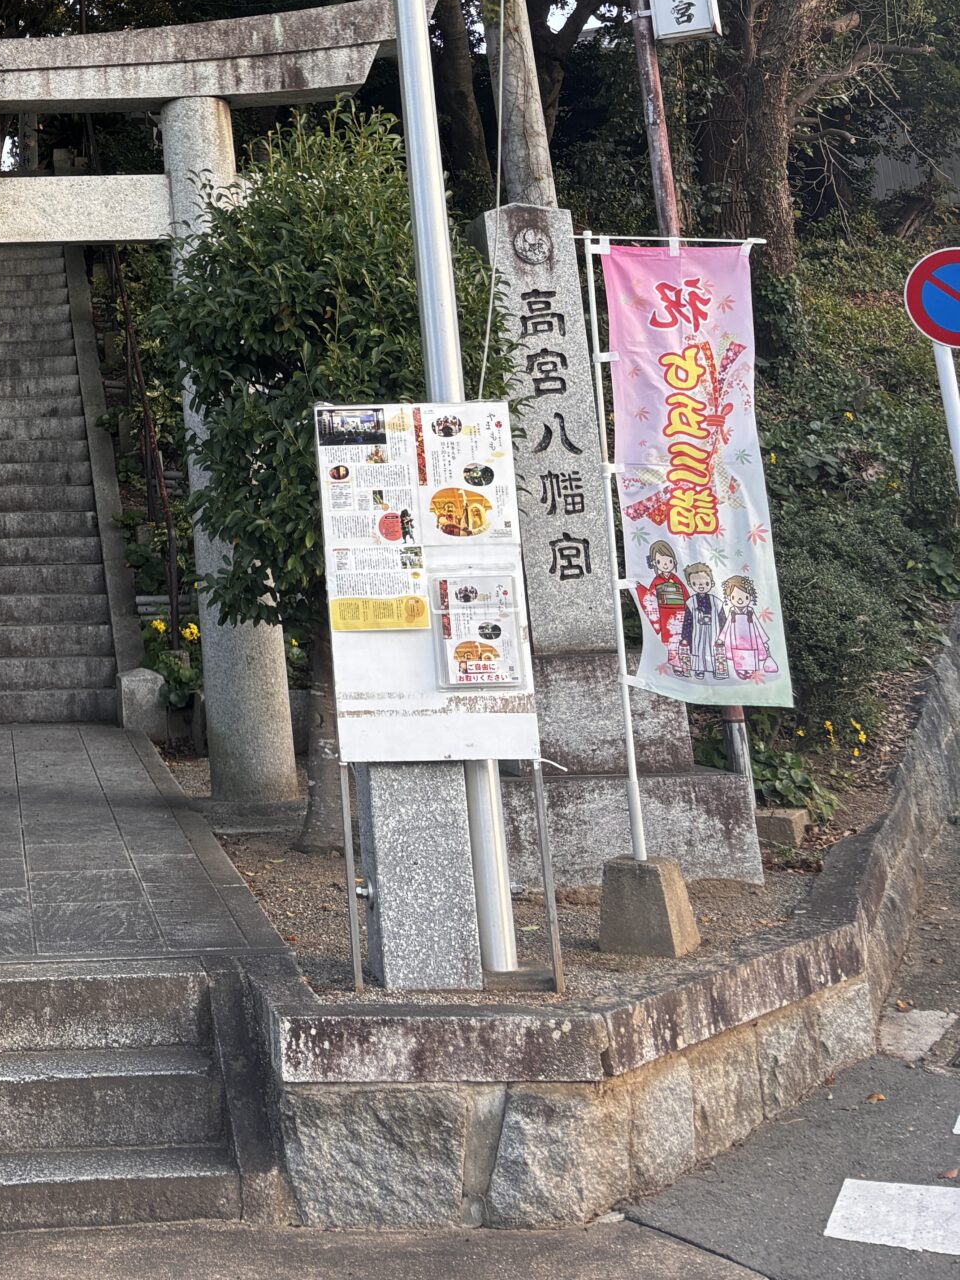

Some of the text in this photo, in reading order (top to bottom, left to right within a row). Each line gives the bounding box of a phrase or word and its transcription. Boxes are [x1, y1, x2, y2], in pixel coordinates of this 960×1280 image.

[520, 288, 591, 581] 高宮八幡宮
[468, 663, 496, 671] ご自由に
[458, 674, 508, 682] お取りください
